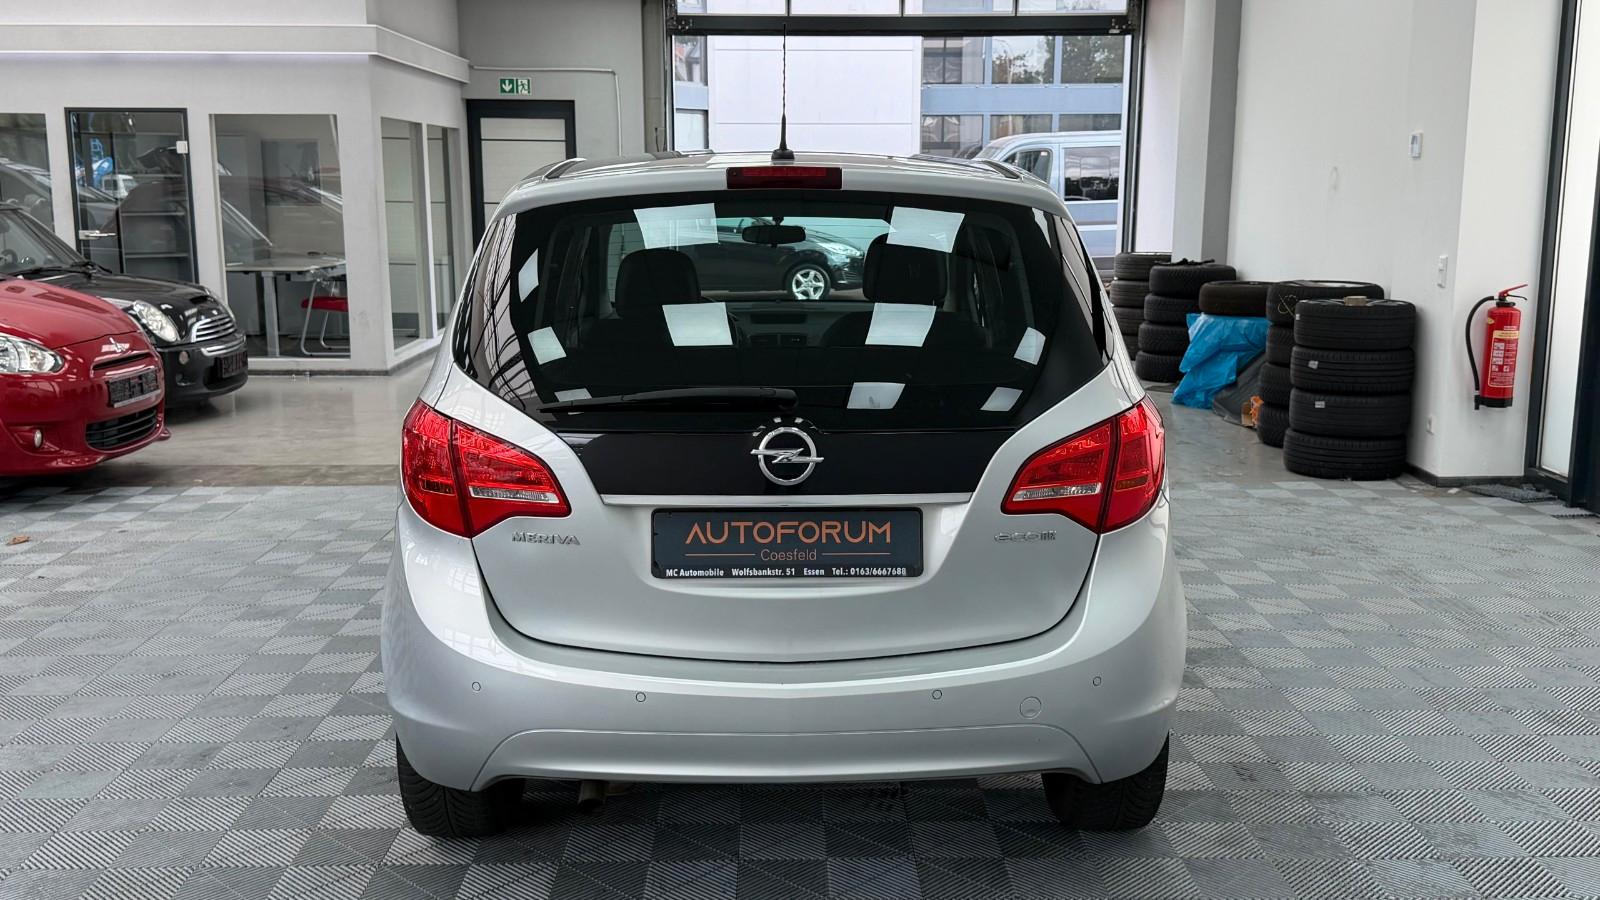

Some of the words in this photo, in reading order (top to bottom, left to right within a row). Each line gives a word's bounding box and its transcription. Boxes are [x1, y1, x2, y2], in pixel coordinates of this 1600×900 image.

[512, 532, 580, 545] MERIVA
[685, 521, 891, 544] AUTOFORUM
[760, 548, 817, 561] Coesfeld
[665, 568, 678, 577] MC
[679, 568, 725, 577] Automobile
[731, 567, 784, 577] Wolfsbankstr.
[786, 567, 795, 576] 51
[803, 567, 825, 576] Essen
[832, 567, 848, 576] Tel.:
